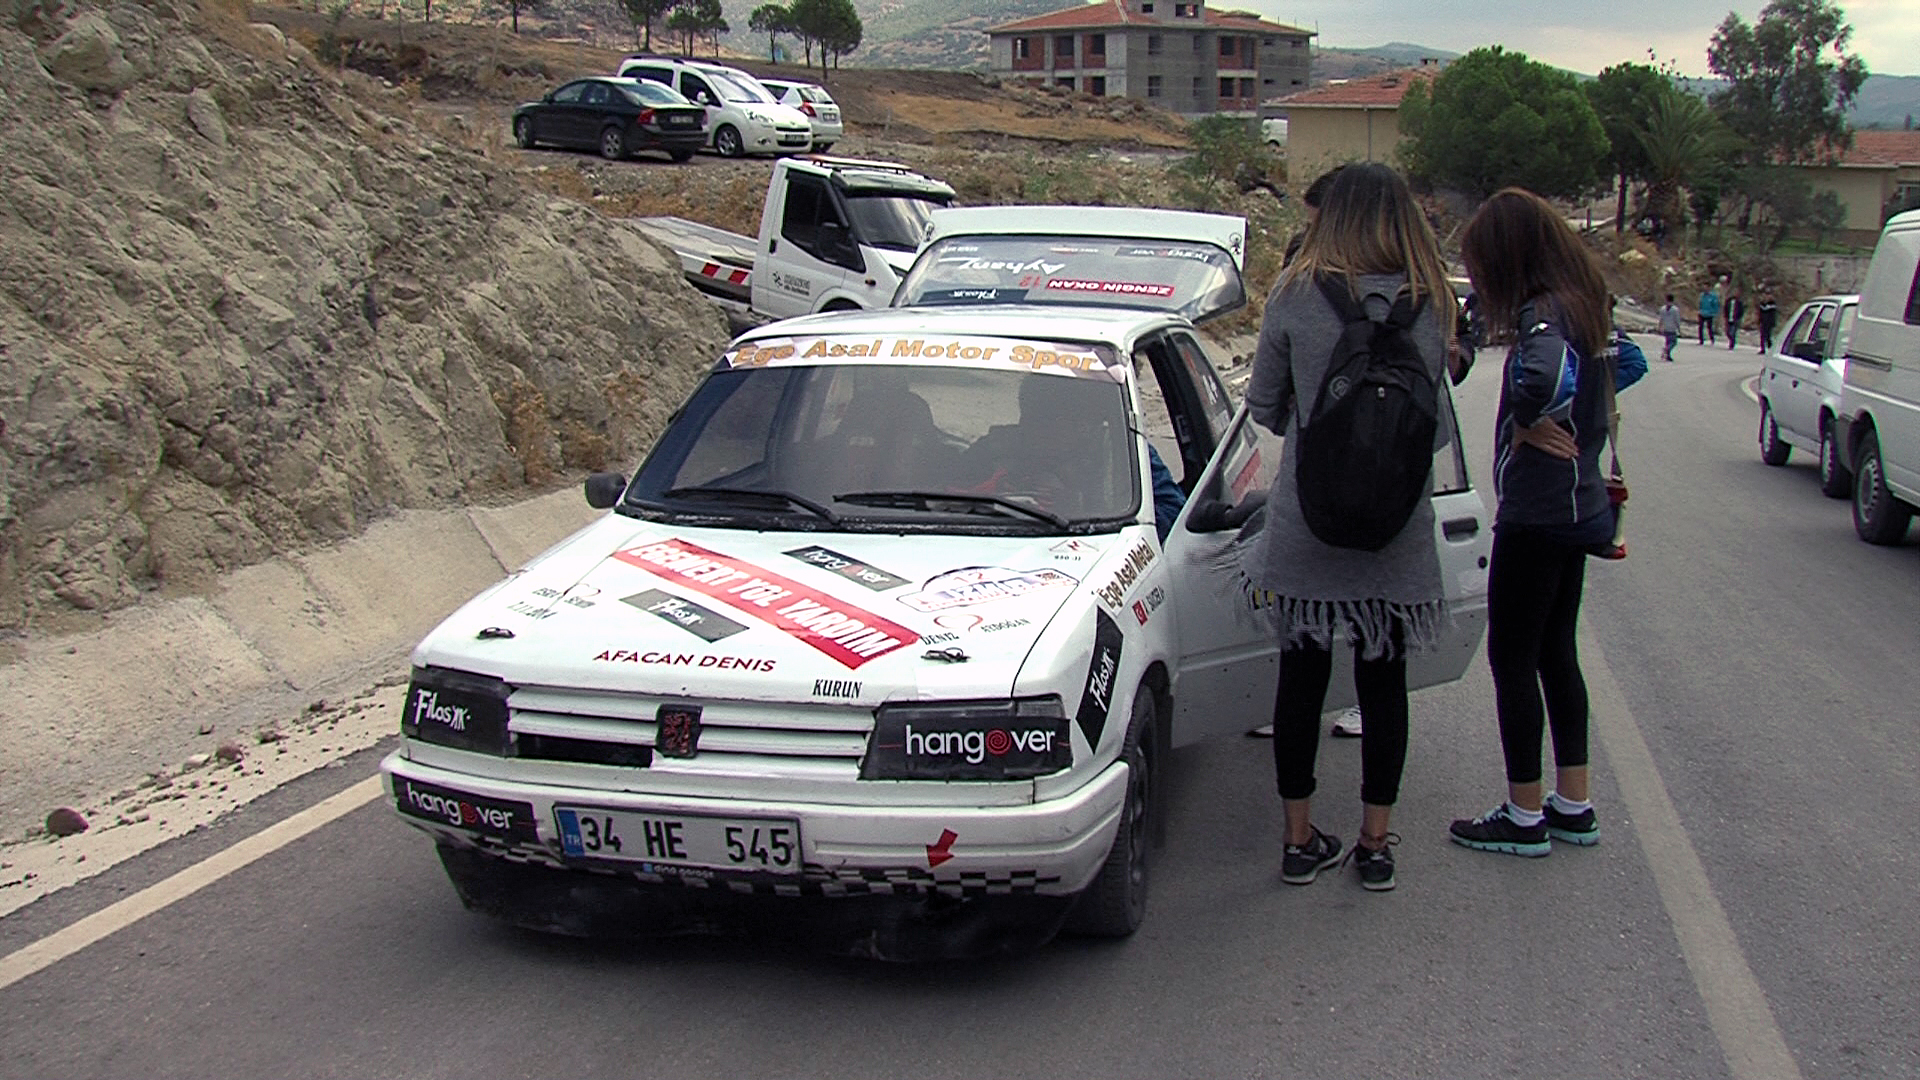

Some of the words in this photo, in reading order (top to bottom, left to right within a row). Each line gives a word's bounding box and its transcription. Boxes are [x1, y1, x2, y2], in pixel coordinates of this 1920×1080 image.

[1049, 280, 1099, 291] OKAN
[731, 345, 795, 365] Ege
[802, 339, 882, 358] Asal
[890, 339, 1001, 361] Motor
[1008, 345, 1101, 371] Spor
[1098, 581, 1124, 609] Ege
[1113, 557, 1138, 591] Asal
[1127, 536, 1155, 573] Metal
[728, 577, 793, 608] YOL
[776, 597, 902, 659] YARDIM
[592, 649, 694, 667] AFACAN
[697, 655, 777, 673] DENIS
[812, 678, 862, 699] KURUN
[906, 724, 1056, 765] hangover
[406, 781, 514, 830] hangover
[565, 834, 581, 847] TR
[580, 816, 622, 852] 34
[642, 819, 687, 859] HE
[724, 826, 793, 867] 545
